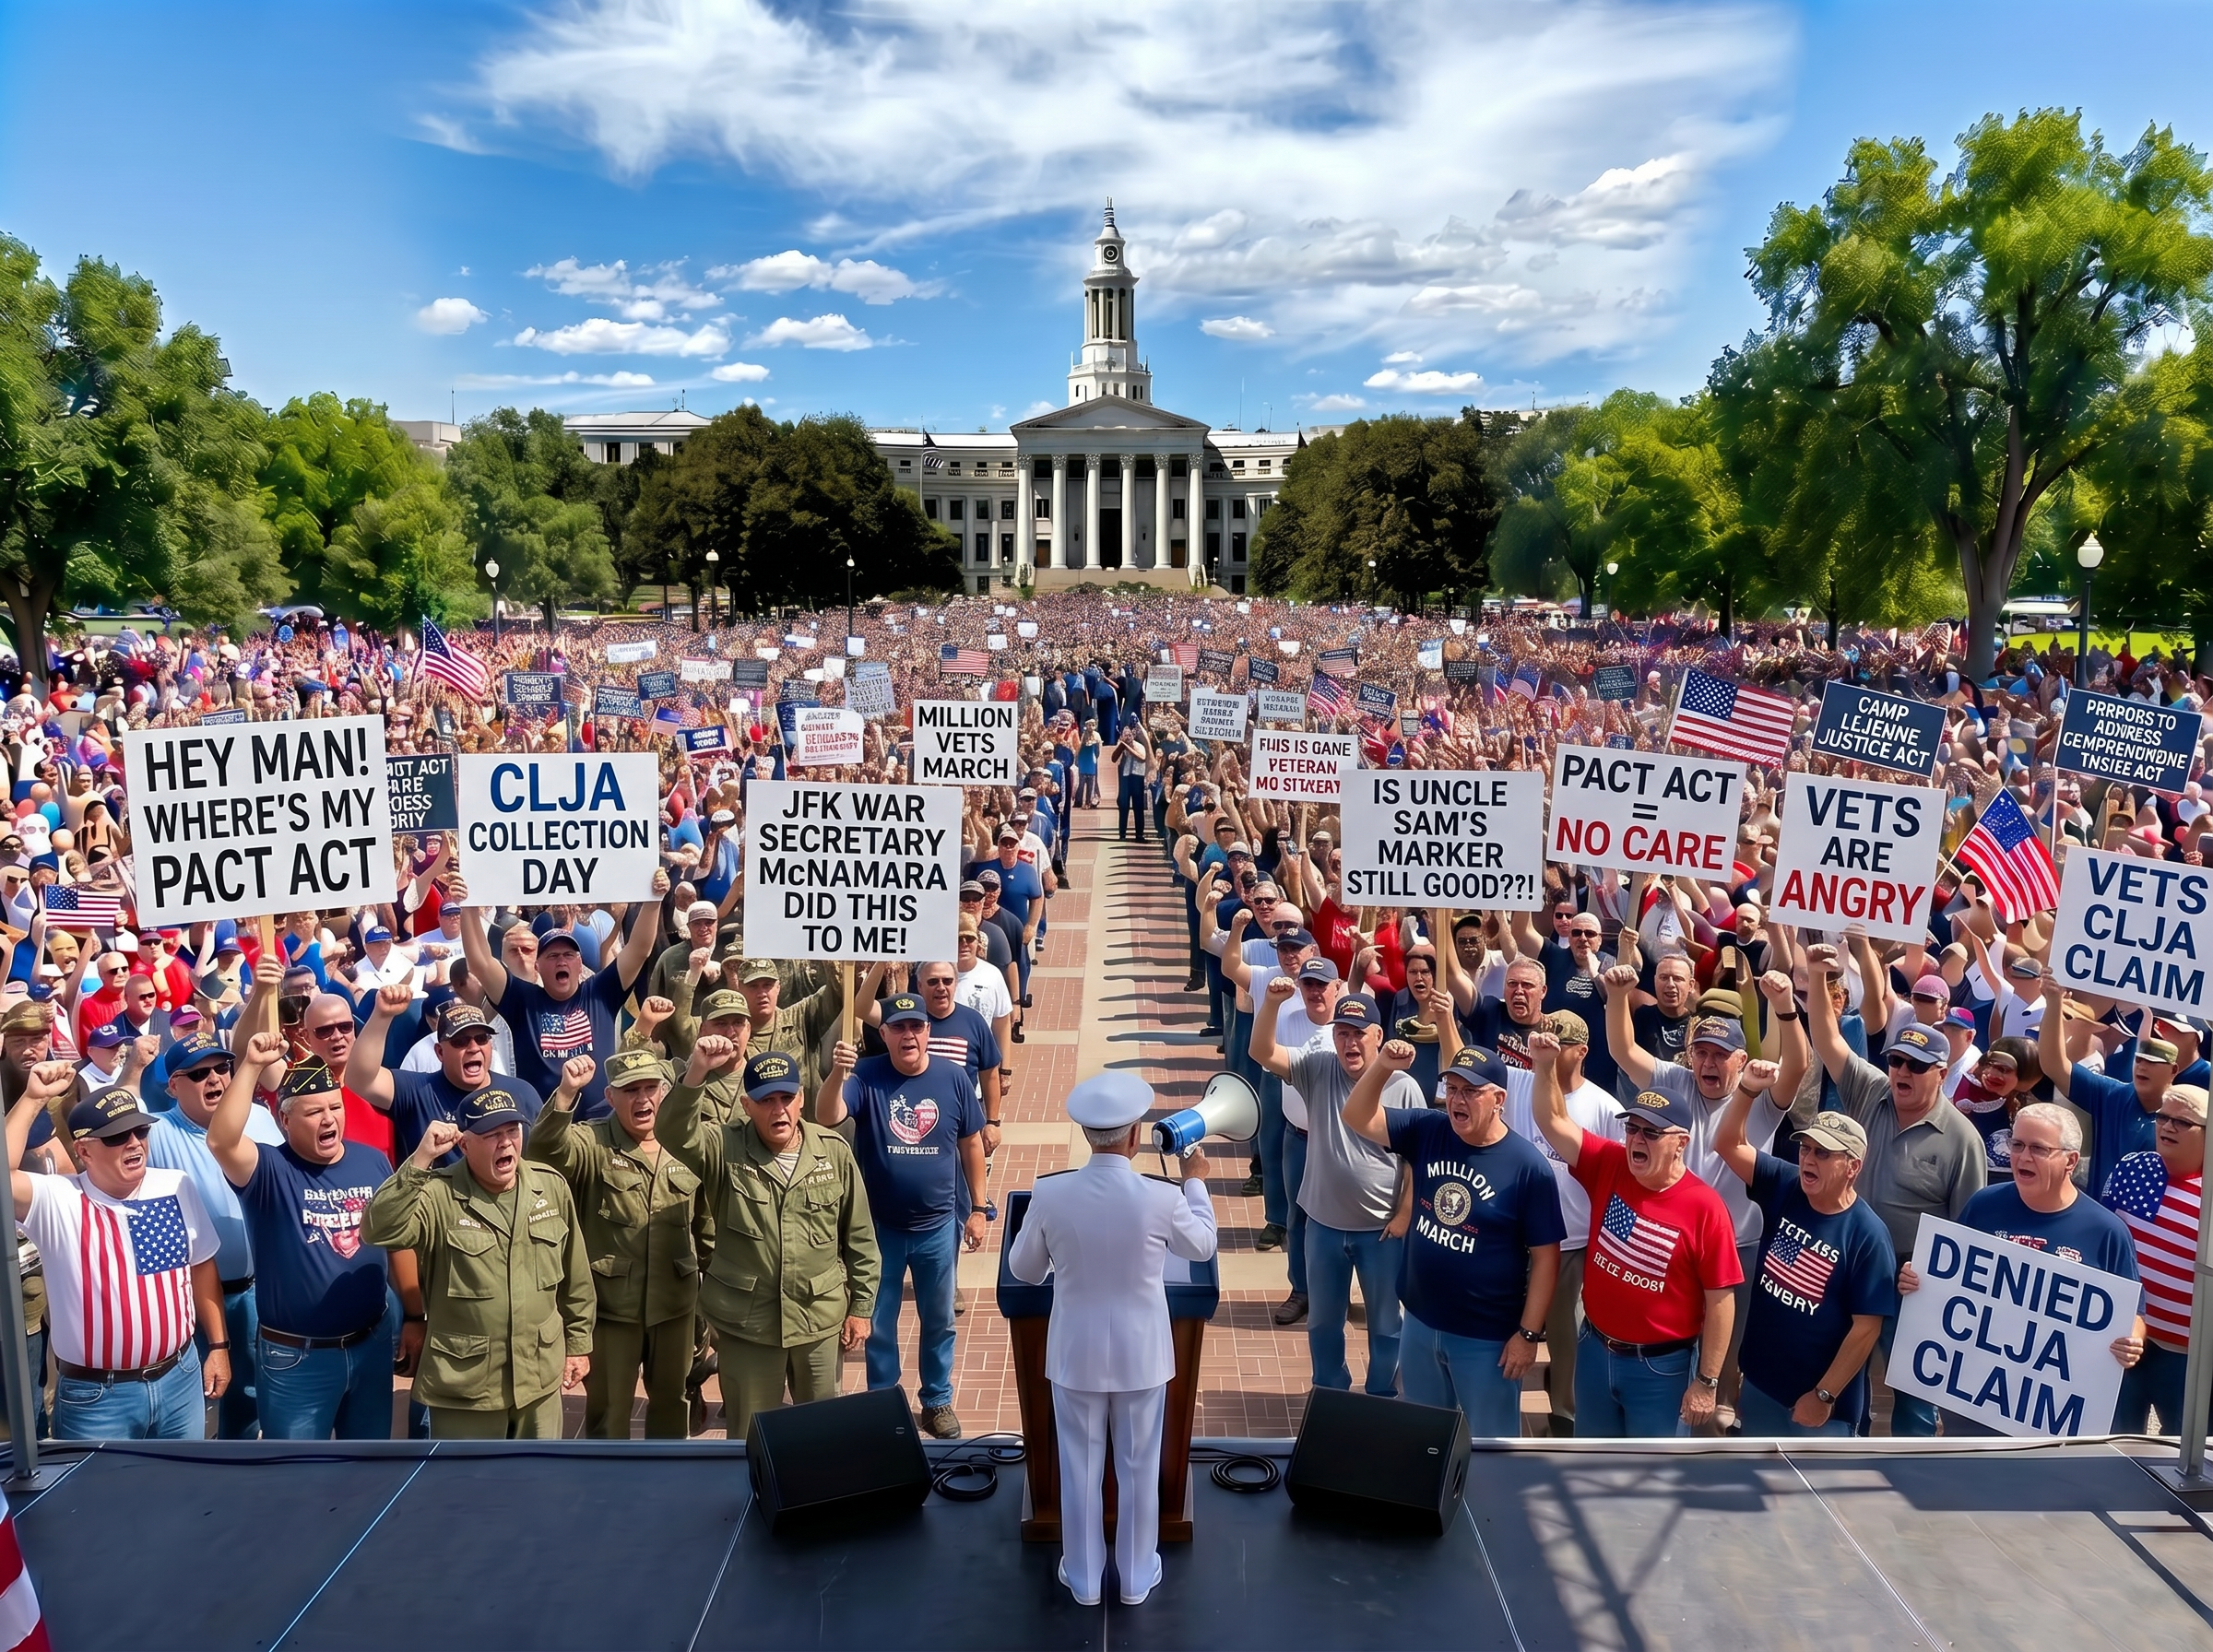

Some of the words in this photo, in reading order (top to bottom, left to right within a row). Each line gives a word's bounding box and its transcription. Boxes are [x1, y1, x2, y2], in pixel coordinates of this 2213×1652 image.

[918, 705, 1012, 728] MILLION
[1858, 696, 1910, 722] CAMP
[2157, 713, 2177, 731] TO
[936, 733, 995, 754] VETS
[1295, 739, 1308, 754] IS
[1840, 713, 1921, 746] LEJENNE
[145, 737, 236, 792] HEY
[252, 727, 370, 784] MAN!
[1817, 728, 1892, 760] JUSTICE
[1893, 747, 1930, 768] ACT
[418, 759, 449, 775] ACT
[923, 758, 1009, 780] MARCH
[1561, 754, 1655, 796] PACT
[1662, 766, 1738, 805] ACT
[2133, 764, 2165, 783] ACT
[490, 761, 627, 813] CLJA
[1373, 779, 1400, 805] IS
[1410, 780, 1508, 808] UNCLE
[143, 792, 311, 844] WHERE'S
[323, 787, 376, 828] MY
[782, 789, 843, 820] JFK
[851, 793, 926, 822] WAR
[1805, 785, 1922, 838] VETS
[468, 820, 649, 852] COLLECTION
[759, 823, 947, 856] SECRETARY
[1393, 809, 1488, 838] SAM'S
[1378, 840, 1505, 869] MARKER
[1556, 817, 1611, 856] NO
[1622, 825, 1727, 871] CARE
[1820, 838, 1893, 874] ARE
[152, 845, 274, 909] PACT
[289, 836, 377, 896] ACT
[522, 857, 599, 895] DAY
[759, 857, 948, 891] McNAMARA
[1347, 870, 1417, 898] STILL
[1423, 872, 1535, 901] GOOD??!
[2088, 857, 2209, 914] VETS
[784, 891, 838, 922] DID
[846, 893, 917, 923] THIS
[1779, 870, 1926, 926] ANGRY
[803, 925, 843, 952] TO
[854, 926, 907, 954] ME!
[2083, 904, 2197, 960] CLJA
[2065, 944, 2205, 1006] CLAIM
[1416, 1215, 1475, 1254] MARCH
[1926, 1233, 2114, 1332] DENIED
[1942, 1295, 2070, 1383] CLJA
[1912, 1339, 2086, 1437] CLAIM
